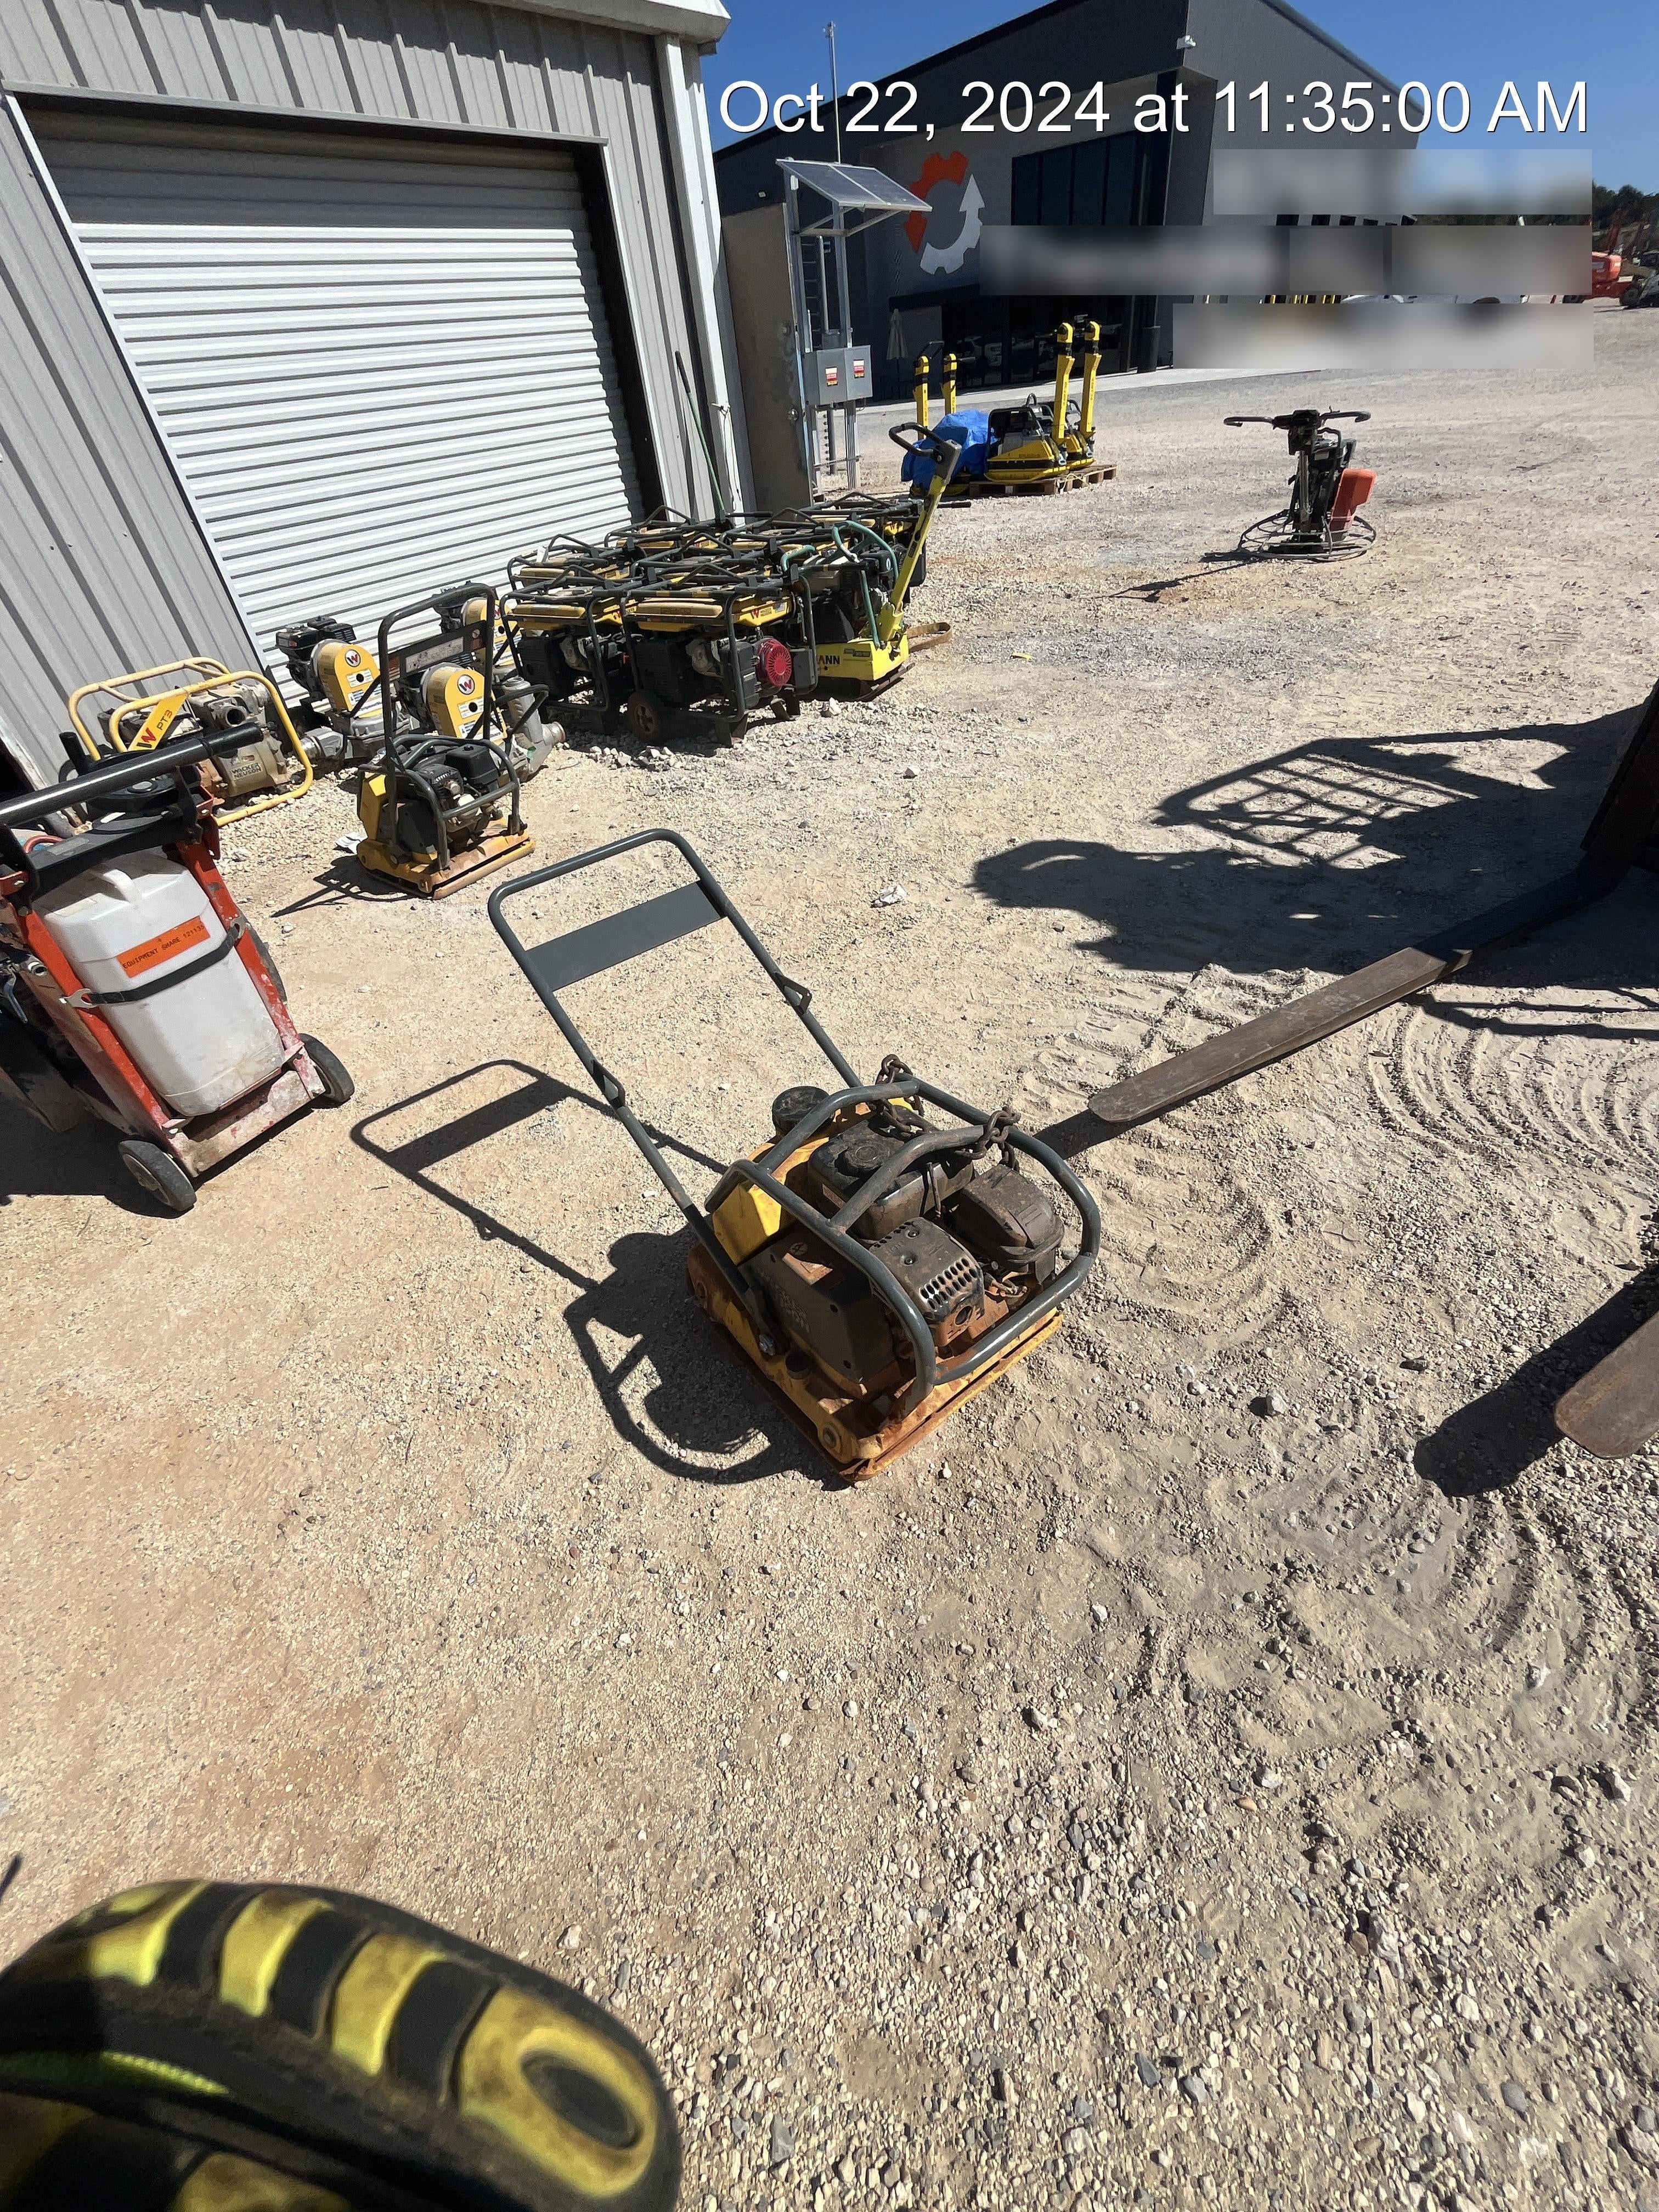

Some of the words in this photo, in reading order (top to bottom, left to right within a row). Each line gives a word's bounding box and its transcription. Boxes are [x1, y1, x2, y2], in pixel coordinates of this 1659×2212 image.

[816, 655, 840, 665] ANN
[156, 709, 173, 731] PT3
[231, 763, 260, 774] WACKER
[234, 768, 262, 778] NEUSON
[122, 948, 159, 969] EQUIPMENT
[161, 936, 182, 951] SHARE
